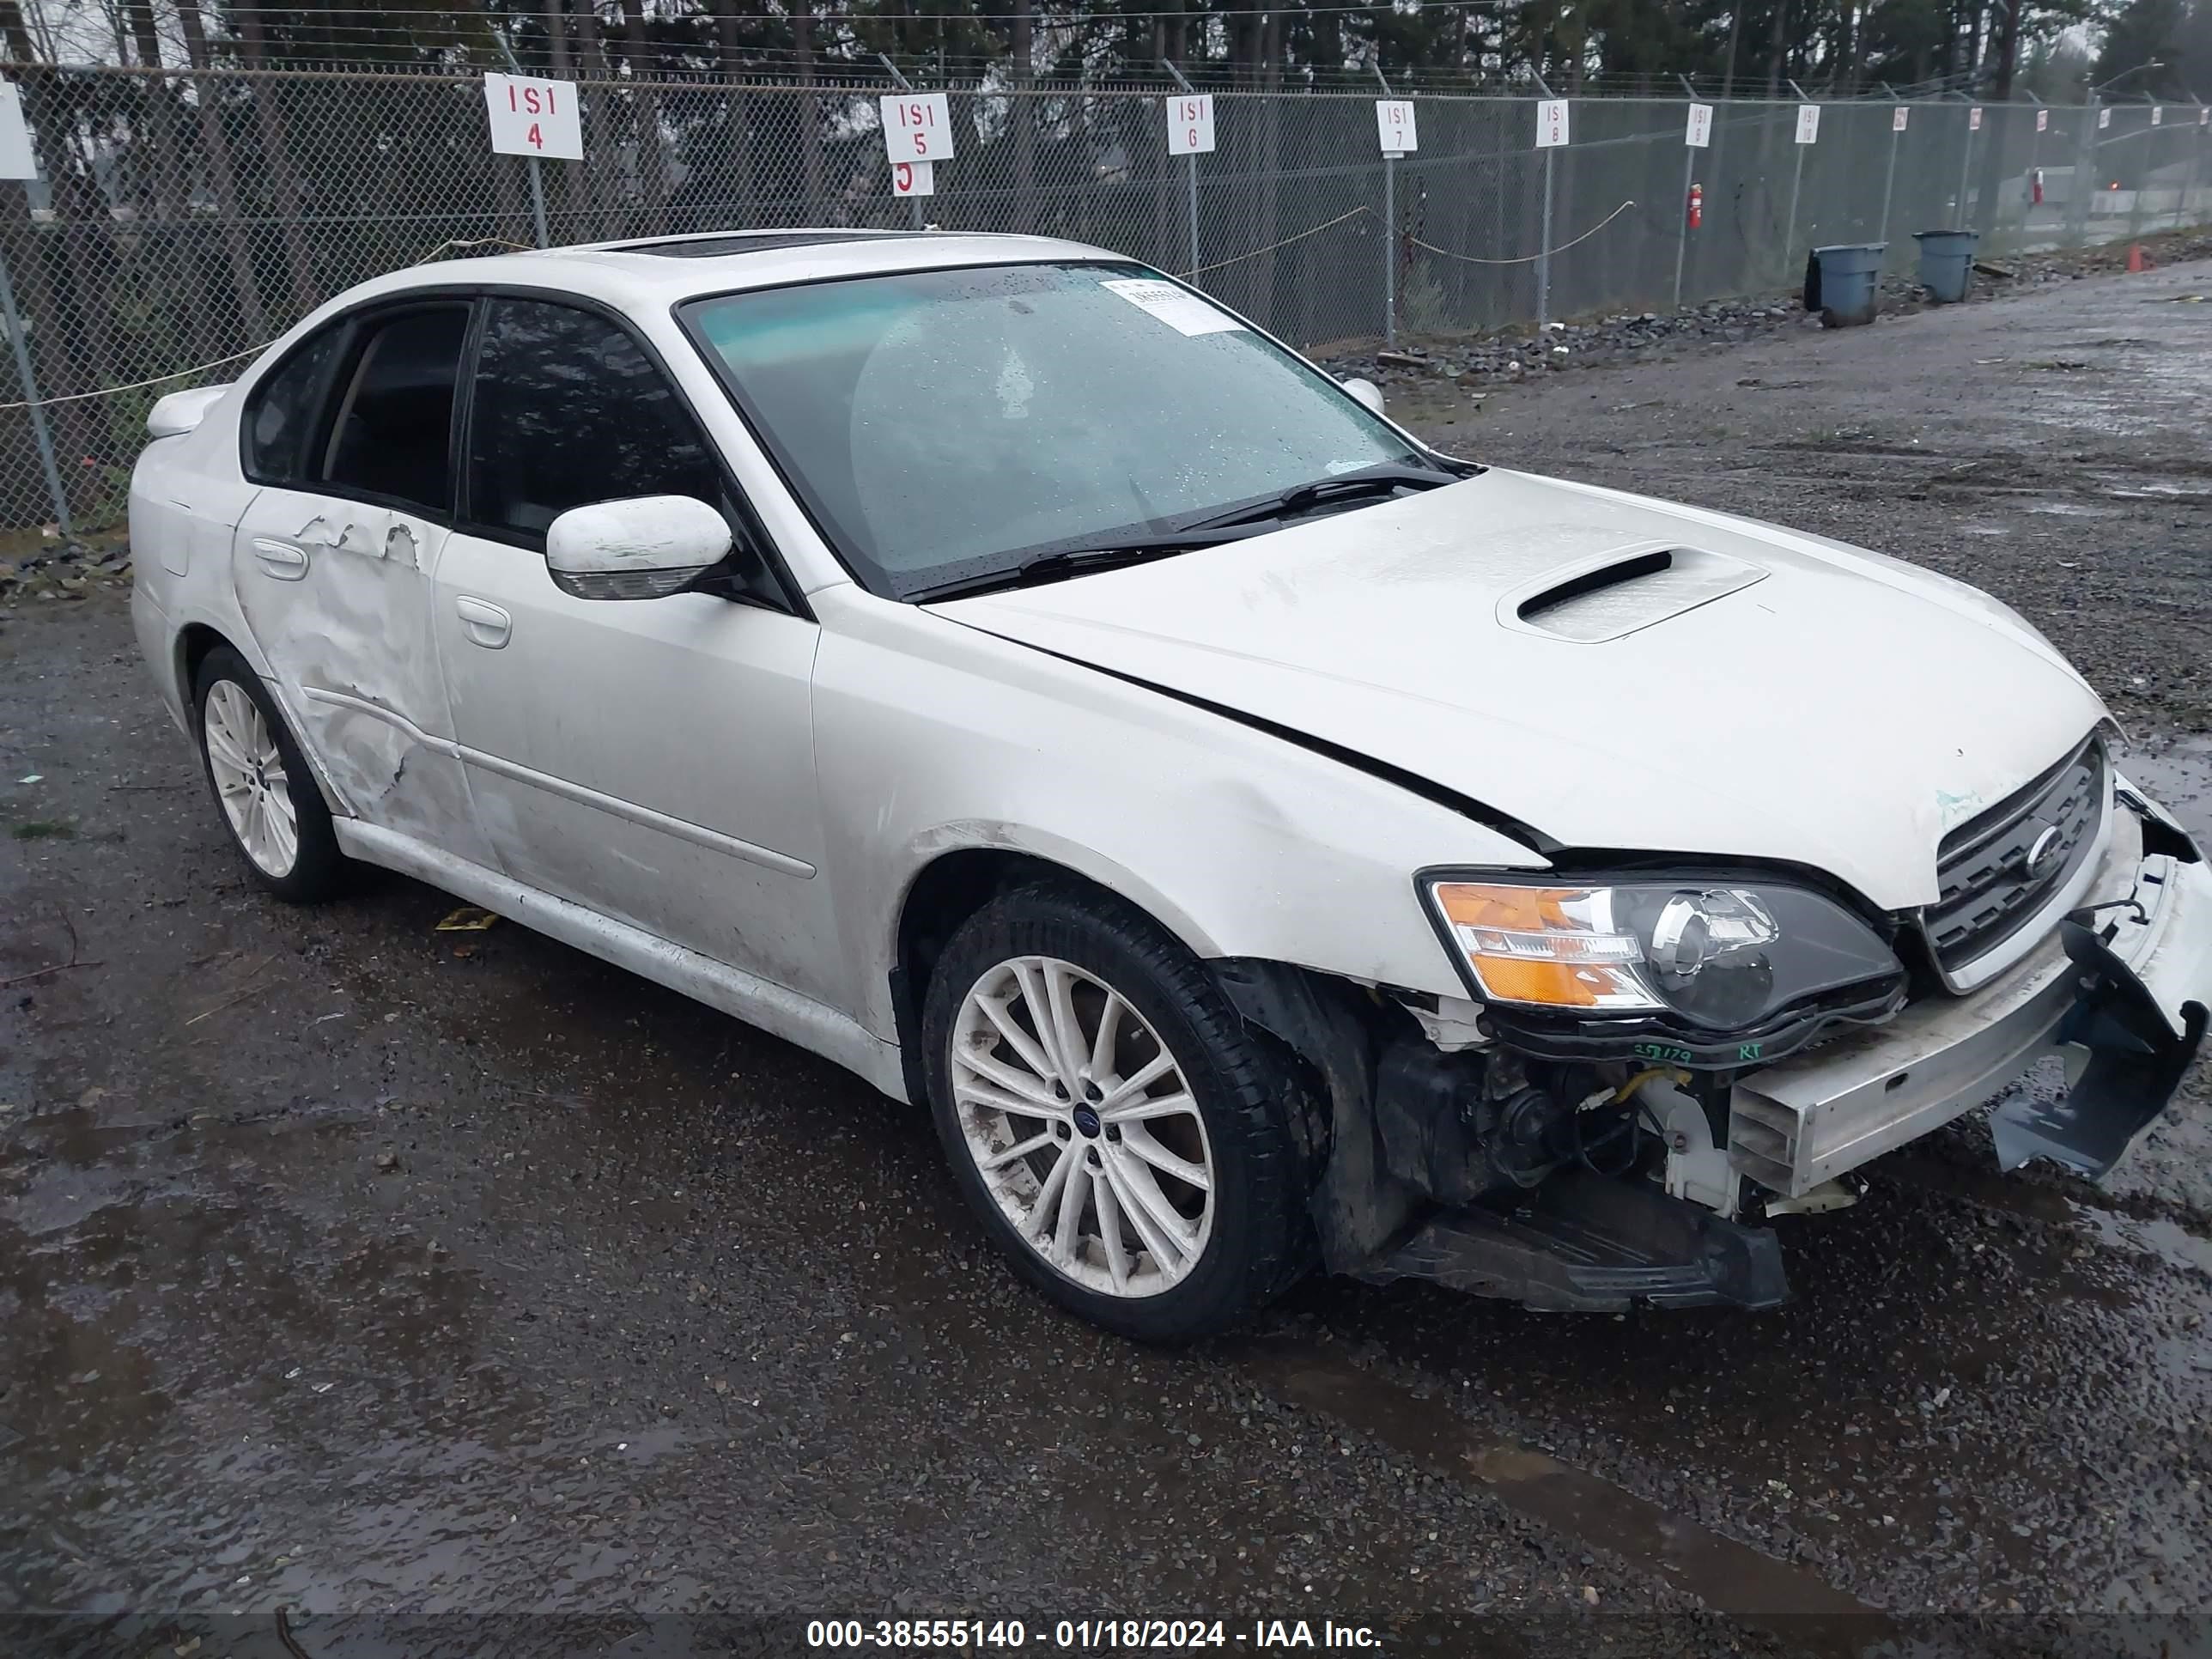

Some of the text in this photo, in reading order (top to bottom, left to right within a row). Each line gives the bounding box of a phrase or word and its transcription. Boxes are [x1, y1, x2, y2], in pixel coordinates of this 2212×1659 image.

[528, 124, 542, 149] 4
[915, 133, 927, 155] 5
[1395, 131, 1402, 147] 7
[1740, 1044, 1762, 1060] RT
